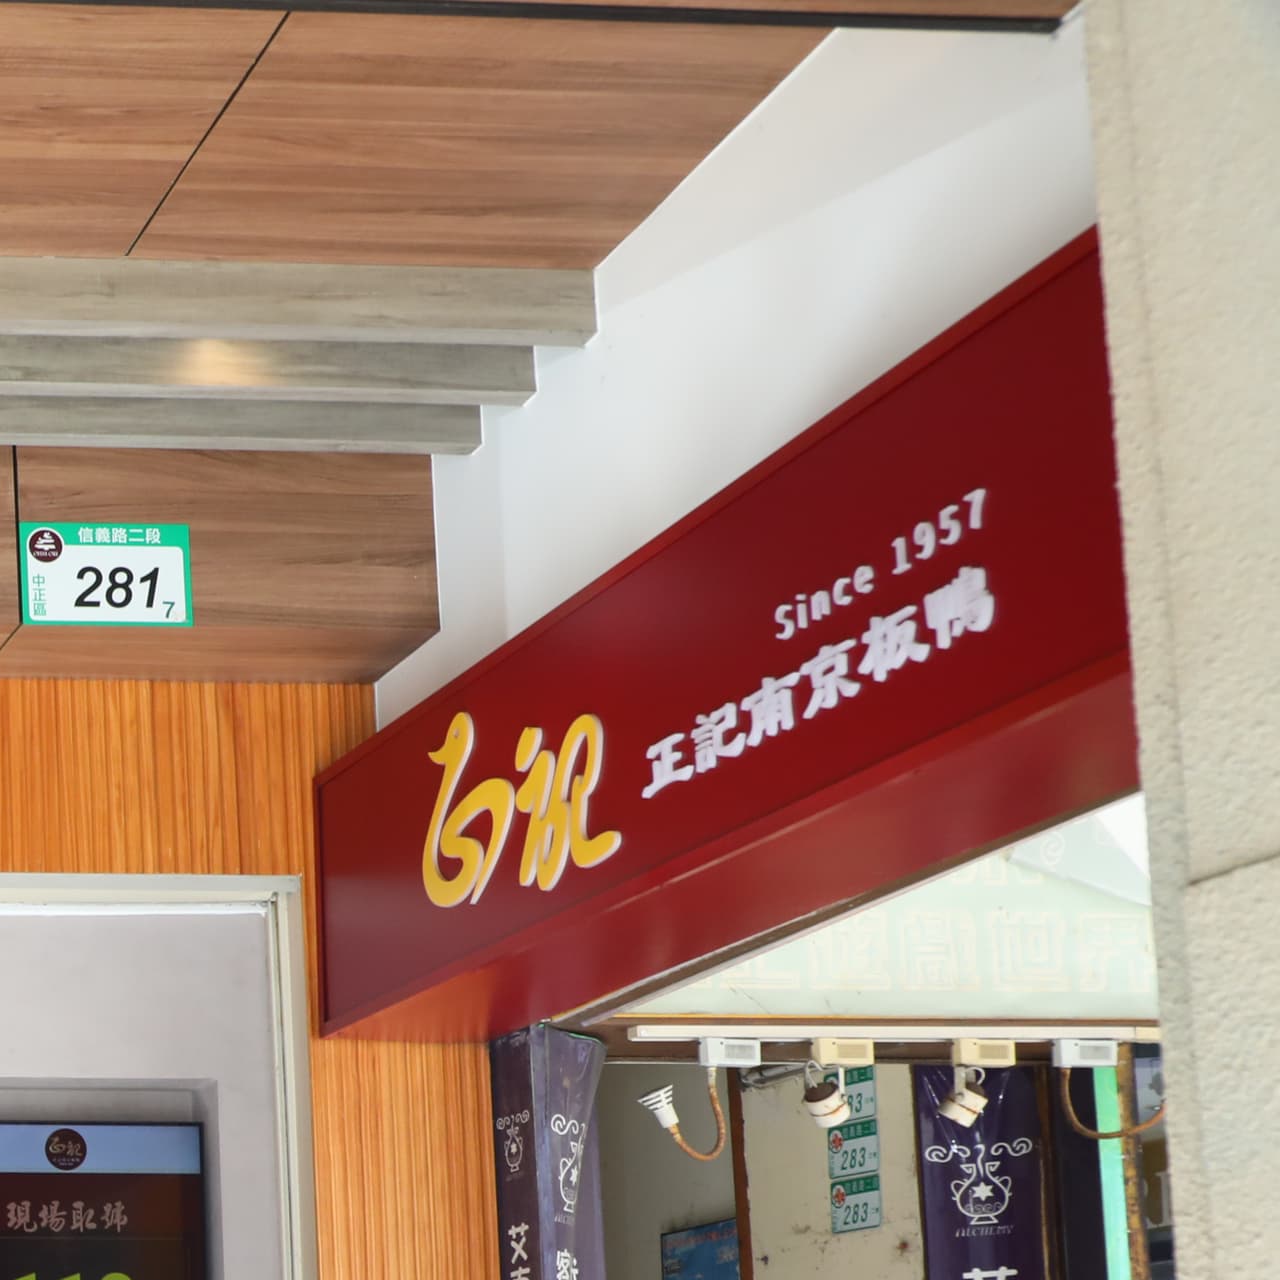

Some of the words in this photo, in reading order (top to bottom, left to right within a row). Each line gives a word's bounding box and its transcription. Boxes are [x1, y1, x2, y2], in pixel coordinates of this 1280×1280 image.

[78, 527, 161, 544] 信義路二段
[773, 564, 875, 640] Since
[891, 487, 988, 575] 1957
[32, 573, 47, 616] 中正區
[74, 566, 160, 608] 281
[162, 601, 176, 618] 7
[641, 566, 995, 799] 正記南京板鴨
[840, 1147, 867, 1171] 283
[843, 1202, 869, 1226] 283
